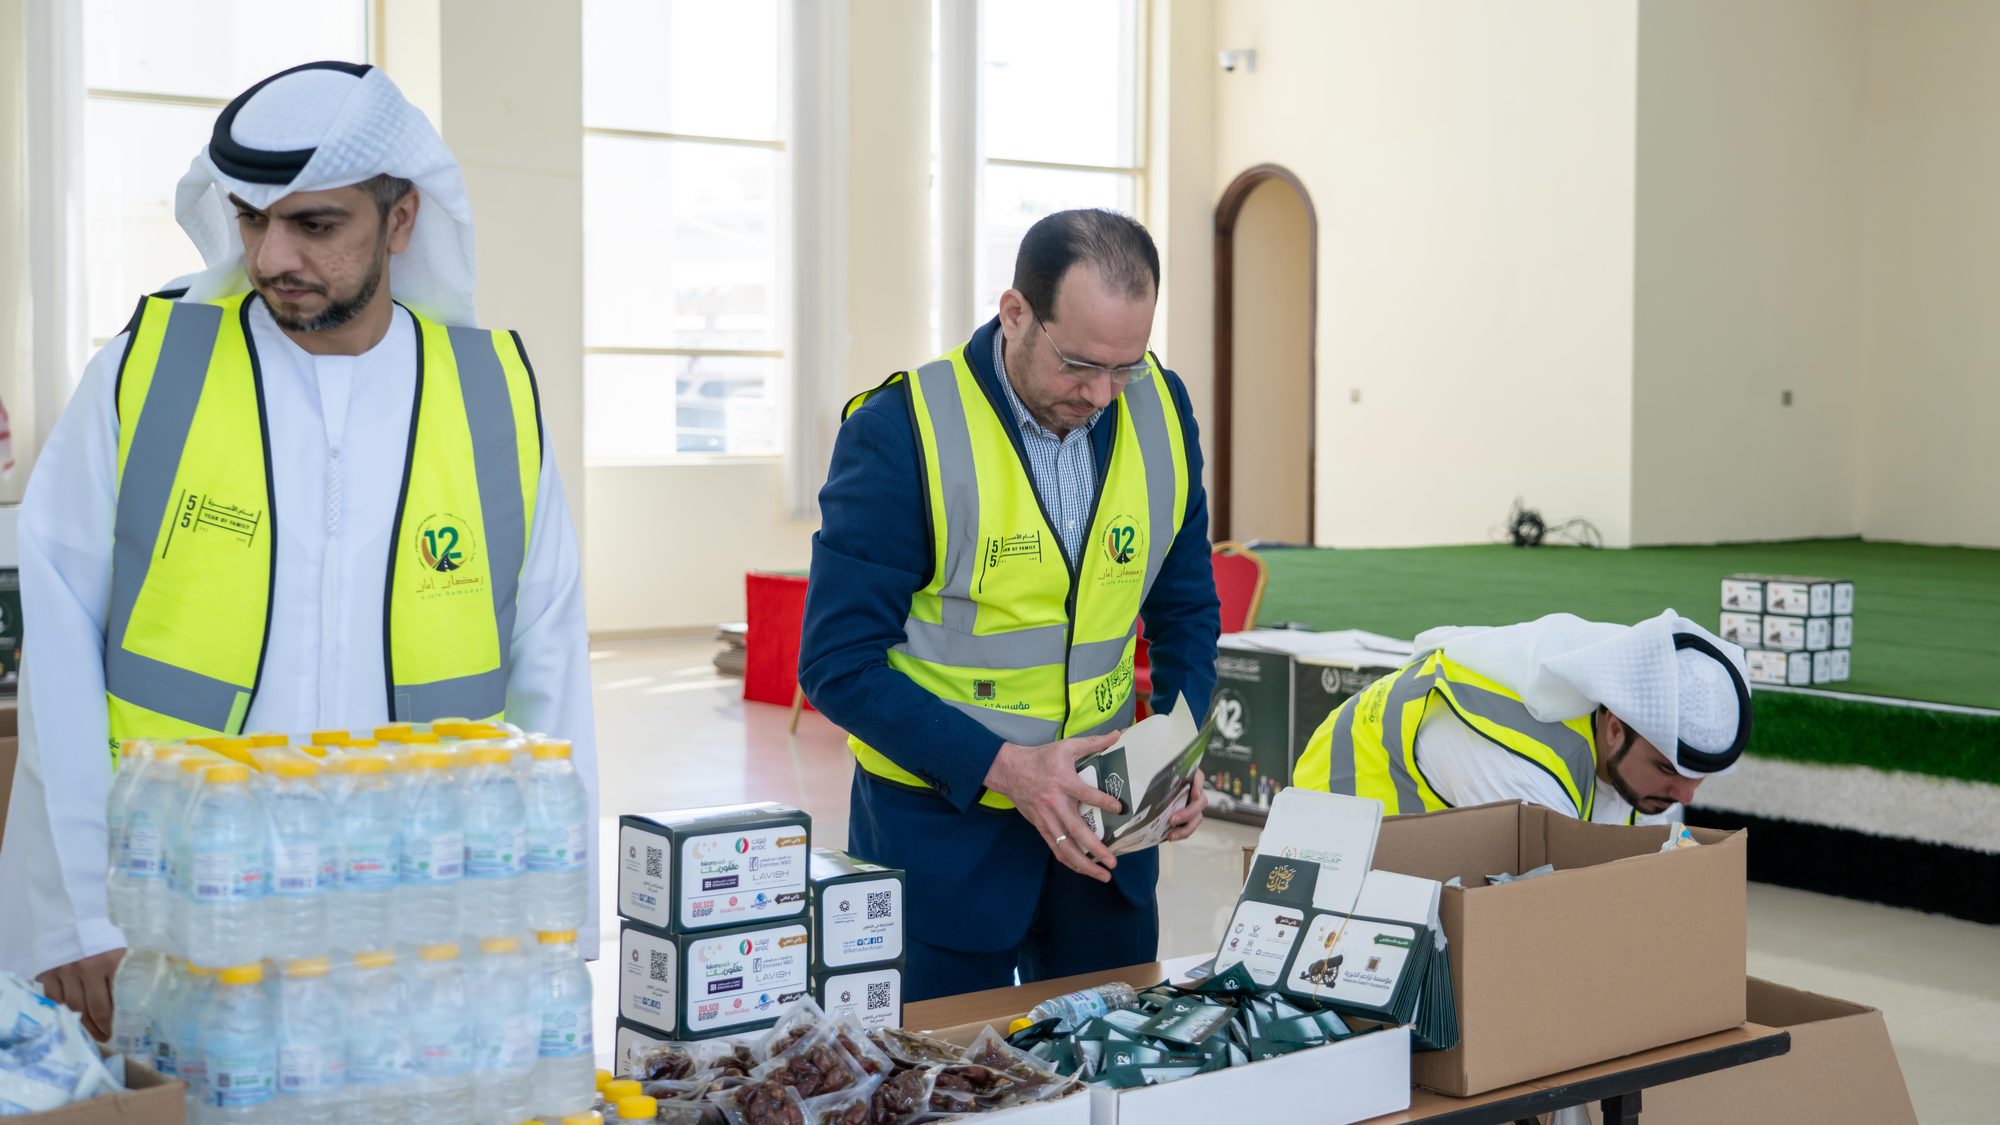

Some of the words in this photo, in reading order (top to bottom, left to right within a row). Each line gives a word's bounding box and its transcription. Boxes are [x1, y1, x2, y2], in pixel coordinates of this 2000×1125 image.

[186, 494, 198, 511] 5
[181, 512, 192, 528] 5
[204, 513, 220, 521] YEAR
[229, 520, 250, 530] FAMILY
[424, 526, 463, 561] 12
[1111, 526, 1135, 554] 12
[991, 540, 998, 553] 5
[990, 555, 998, 567] 5
[753, 870, 790, 881] LAVISH
[692, 900, 715, 910] DULSCO
[692, 908, 713, 917] GROUP
[756, 970, 791, 982] LAVISH
[698, 1003, 720, 1013] DULSCO
[698, 1011, 718, 1021] GROUP
